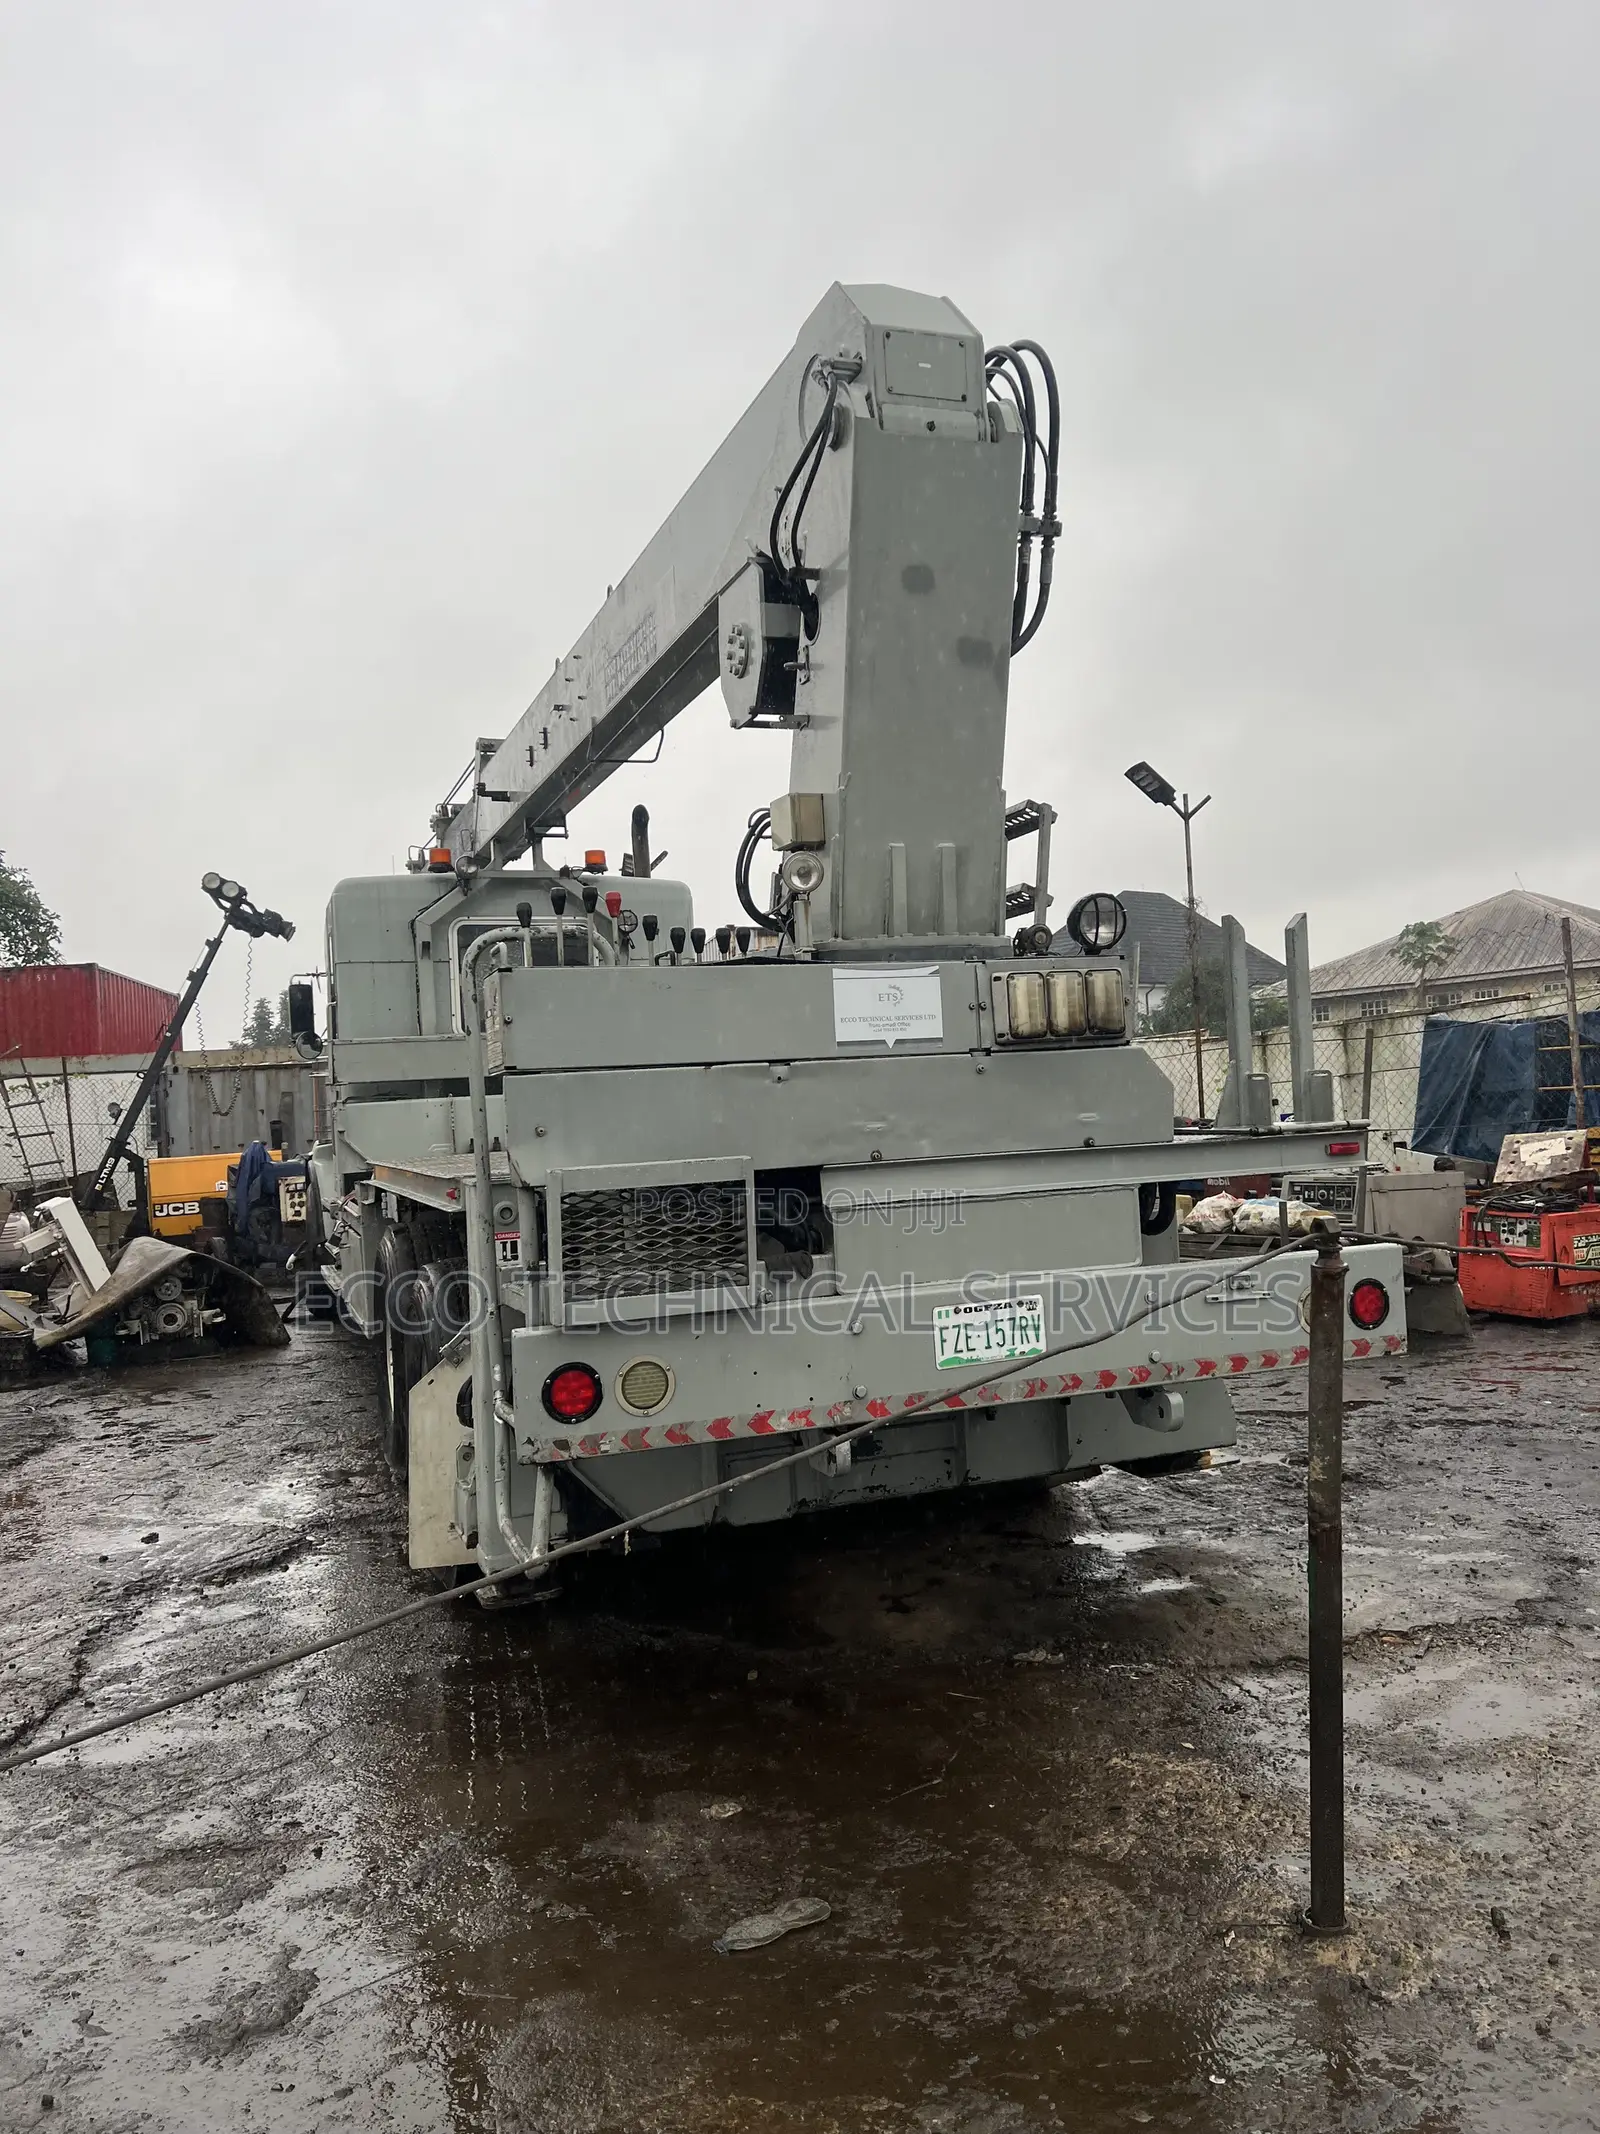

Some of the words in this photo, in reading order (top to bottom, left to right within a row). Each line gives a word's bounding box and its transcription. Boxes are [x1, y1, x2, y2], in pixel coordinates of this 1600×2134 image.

[878, 992, 899, 1002] ETS
[840, 1016, 857, 1024] ECCO
[155, 1201, 200, 1217] JCB
[963, 1302, 1013, 1314] OGFZA
